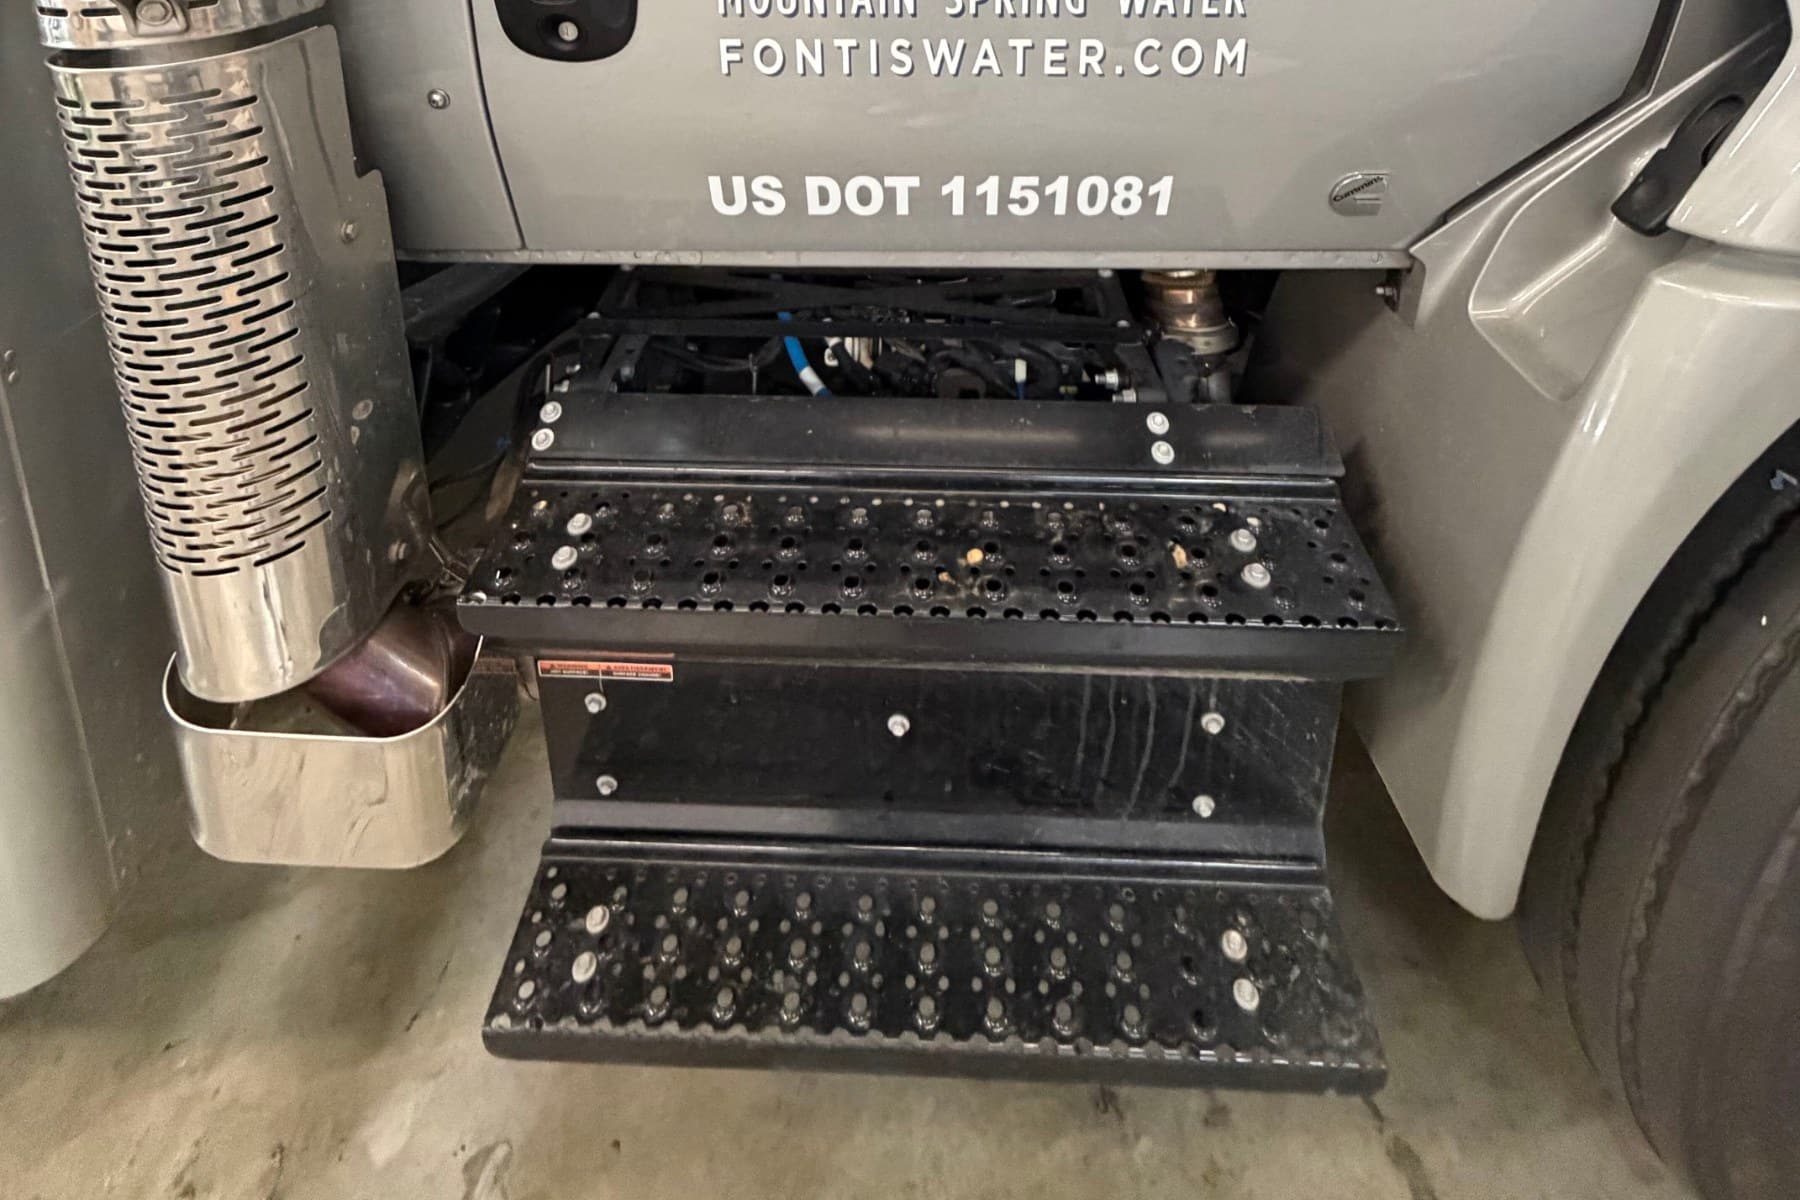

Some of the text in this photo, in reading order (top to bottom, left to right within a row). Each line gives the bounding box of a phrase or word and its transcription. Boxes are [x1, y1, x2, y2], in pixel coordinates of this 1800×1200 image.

[718, 38, 1249, 77] FONTISWATER.COM
[707, 175, 1175, 216] US DOT 1151081
